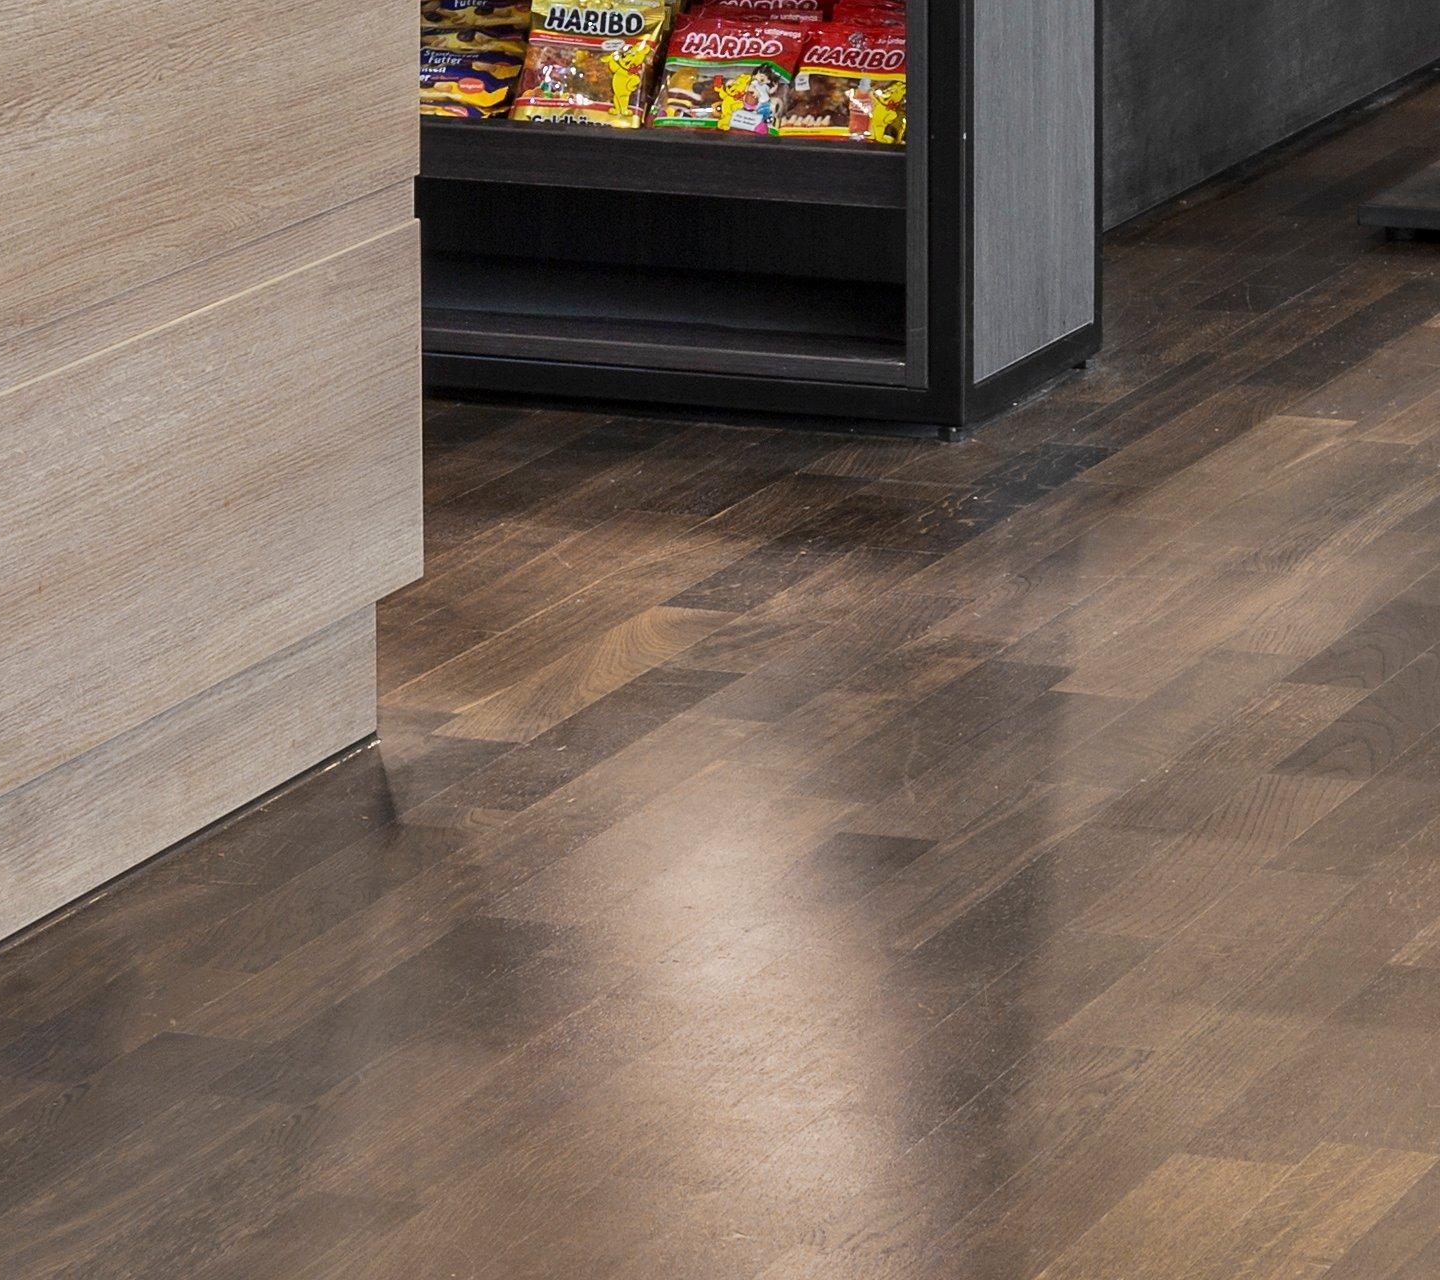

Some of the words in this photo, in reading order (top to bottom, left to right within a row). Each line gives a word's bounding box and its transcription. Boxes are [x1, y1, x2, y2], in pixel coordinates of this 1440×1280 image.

[545, 6, 644, 36] HARIBO
[682, 33, 783, 59] HARIBO
[804, 46, 905, 71] HARIBO
